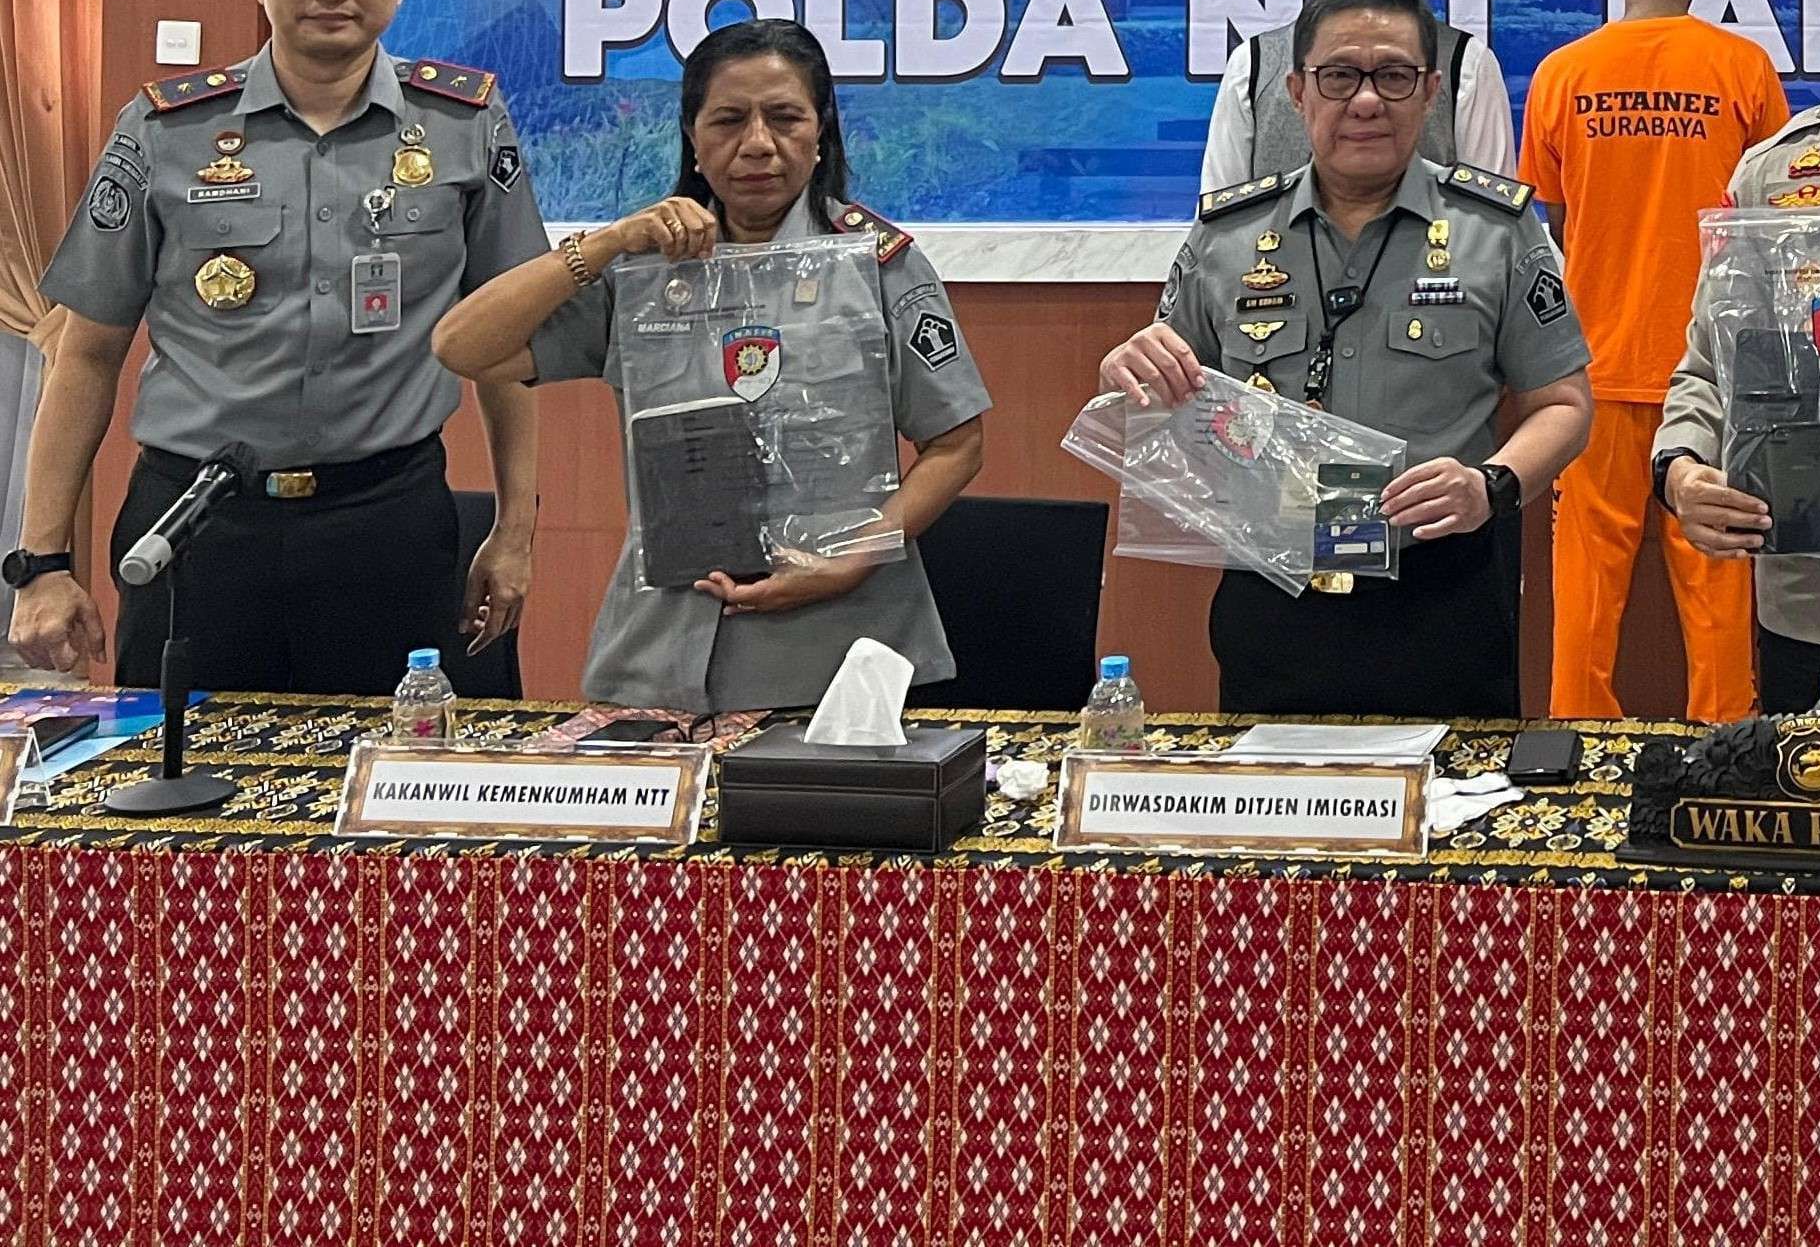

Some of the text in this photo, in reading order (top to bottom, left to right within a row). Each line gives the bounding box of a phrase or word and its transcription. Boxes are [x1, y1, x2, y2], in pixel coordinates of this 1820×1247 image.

[1574, 91, 1721, 117] DETAINEE
[1586, 116, 1708, 140] SURABAYA
[372, 782, 670, 807] KAKANWIL KEMENKUMHAM NTT
[1088, 793, 1398, 819] DIRWASDAKIM DITJEN IMIGRASI
[1687, 807, 1793, 844] WAKA
